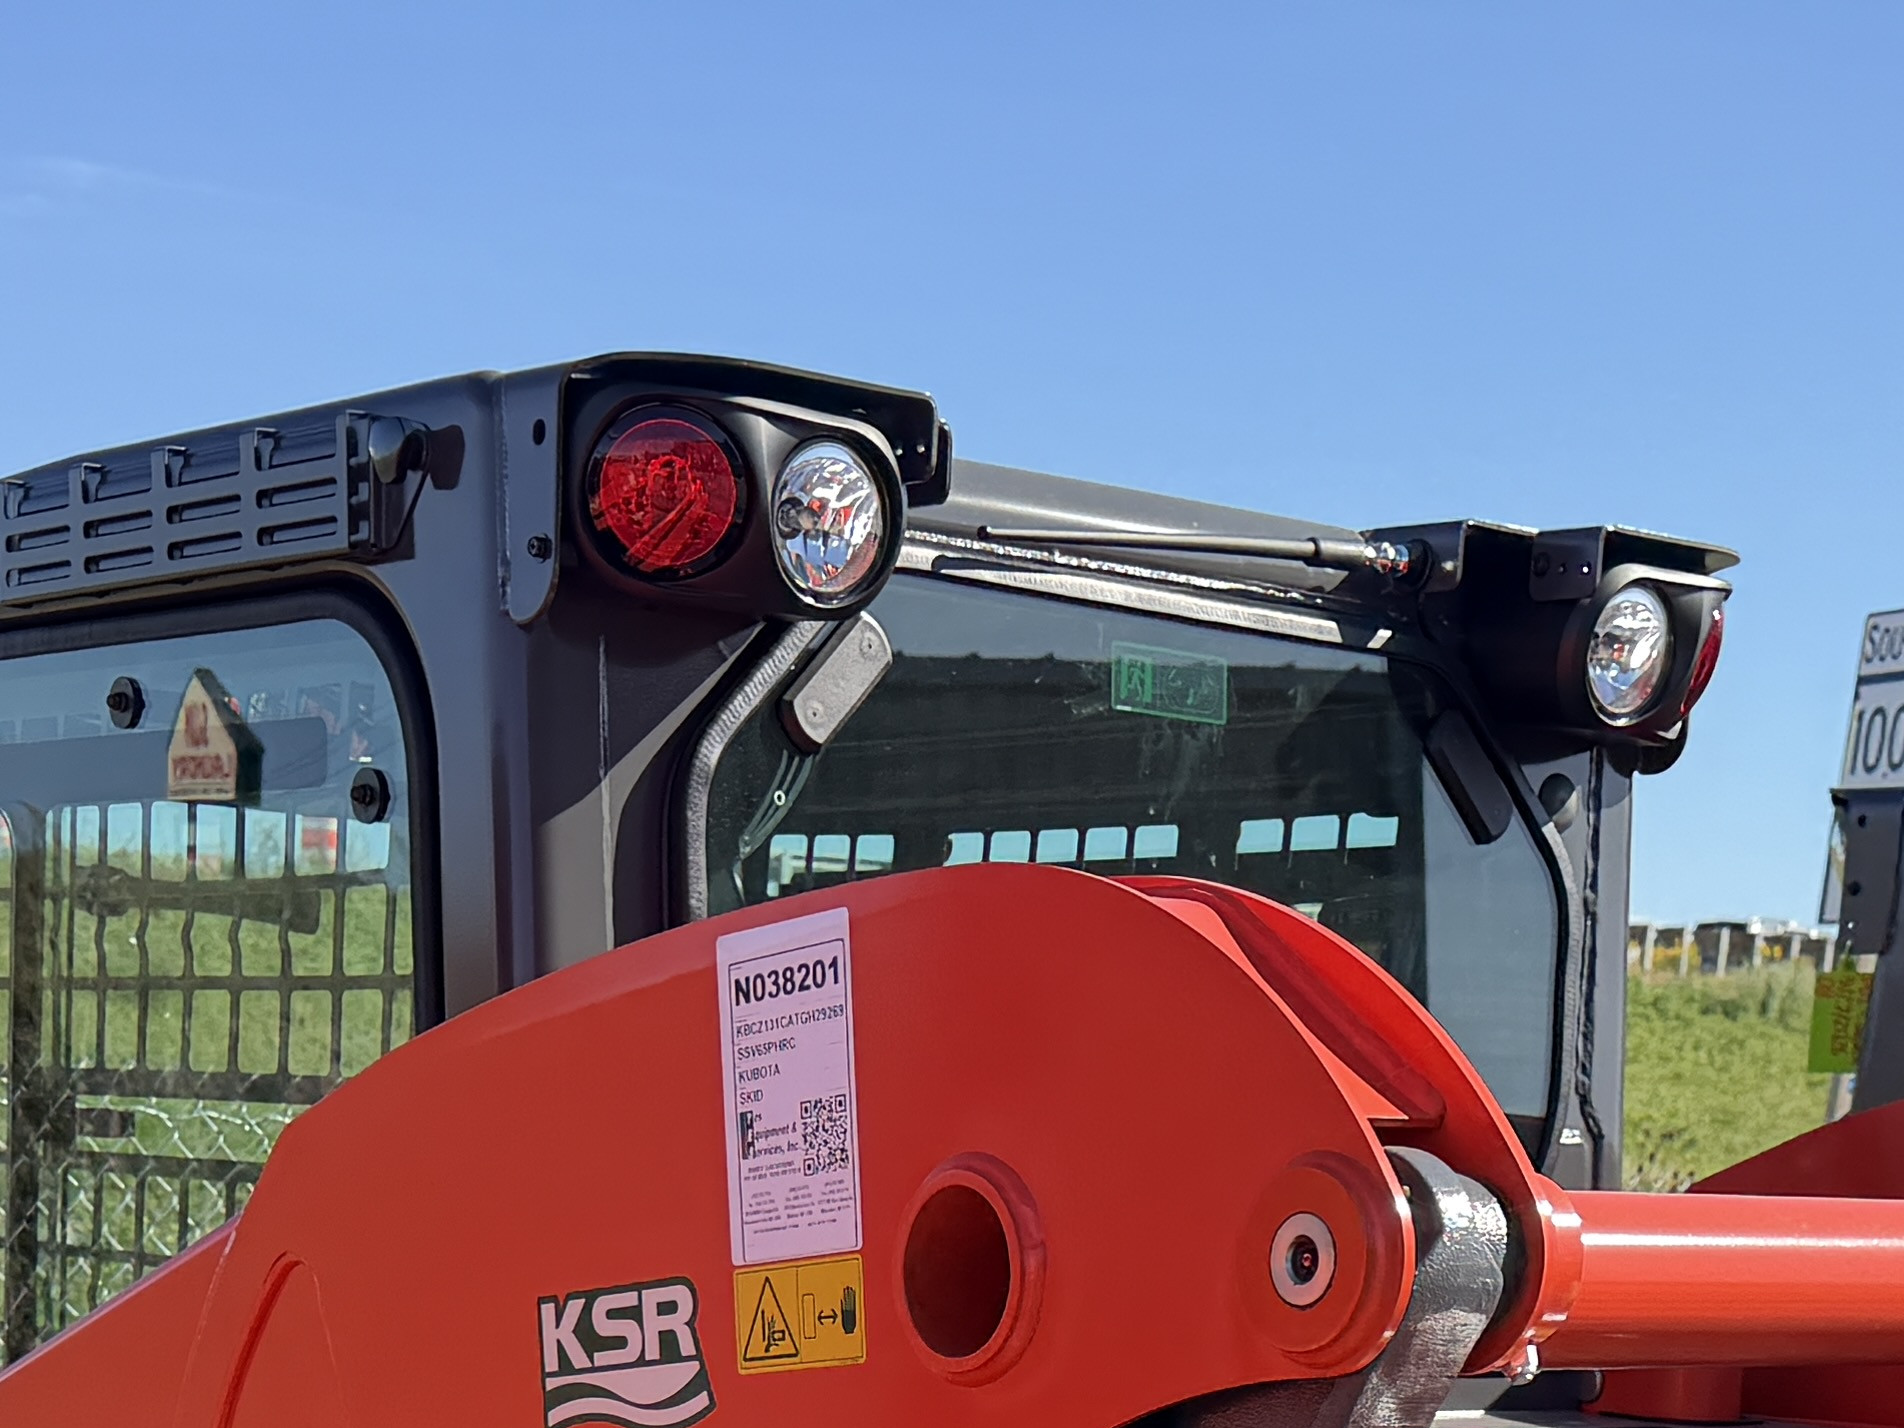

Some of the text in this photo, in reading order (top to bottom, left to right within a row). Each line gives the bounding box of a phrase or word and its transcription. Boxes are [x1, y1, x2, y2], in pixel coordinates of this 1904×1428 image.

[734, 955, 839, 1007] N038201
[738, 1063, 781, 1084] KUBOTA
[540, 1285, 696, 1372] KSR
